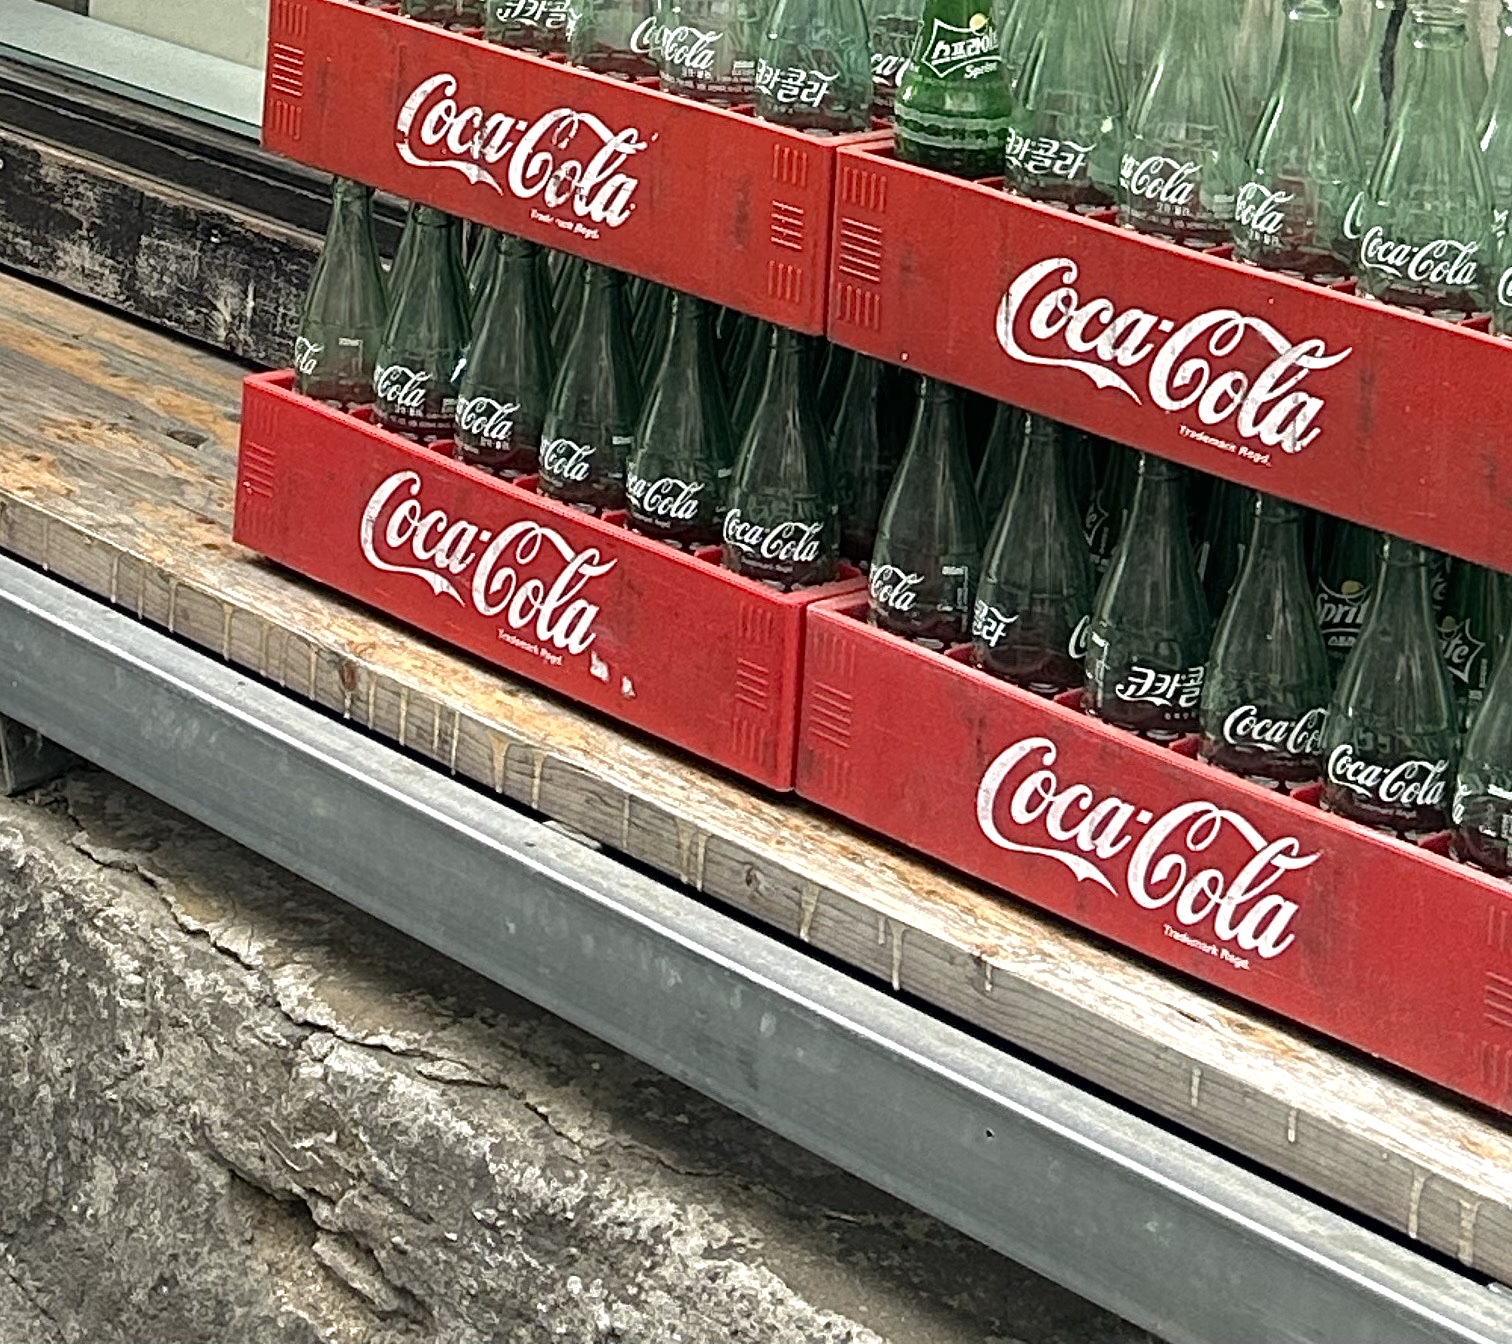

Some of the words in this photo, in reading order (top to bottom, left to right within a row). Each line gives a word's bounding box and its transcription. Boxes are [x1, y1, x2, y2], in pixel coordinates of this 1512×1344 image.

[396, 73, 650, 228] Coca-Cola
[1360, 226, 1479, 285] Coca-Cola
[996, 257, 1353, 454] Coca-Cola
[359, 470, 616, 656] Coca-Cola
[722, 508, 824, 562] Coca-Cola
[976, 736, 1320, 958] Coca-Cola
[1328, 744, 1450, 805] Coca-Cola
